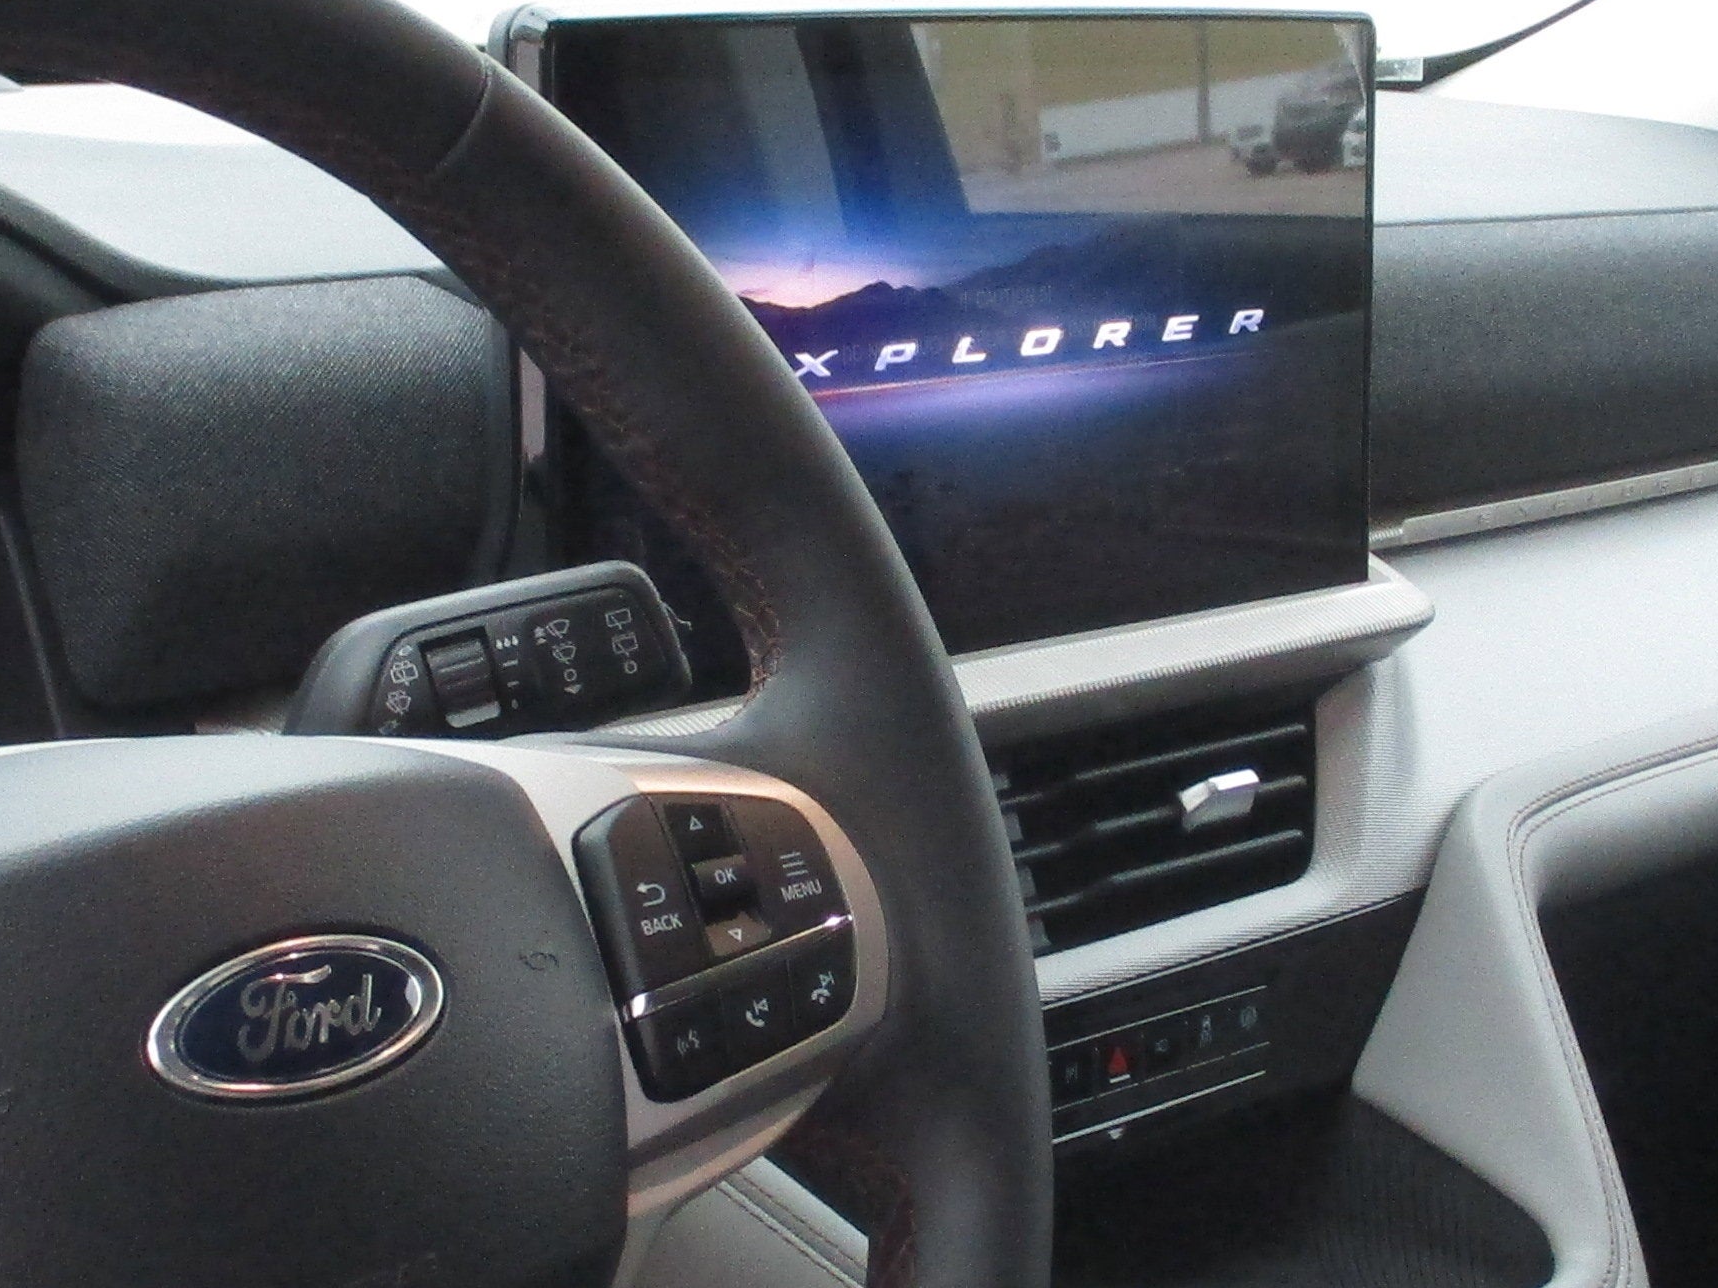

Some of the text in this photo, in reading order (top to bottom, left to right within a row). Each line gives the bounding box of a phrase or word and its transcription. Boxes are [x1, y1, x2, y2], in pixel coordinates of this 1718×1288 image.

[713, 866, 738, 885] OK
[780, 879, 823, 903] MENU
[640, 914, 683, 937] BACK
[236, 964, 383, 1063] Ford
